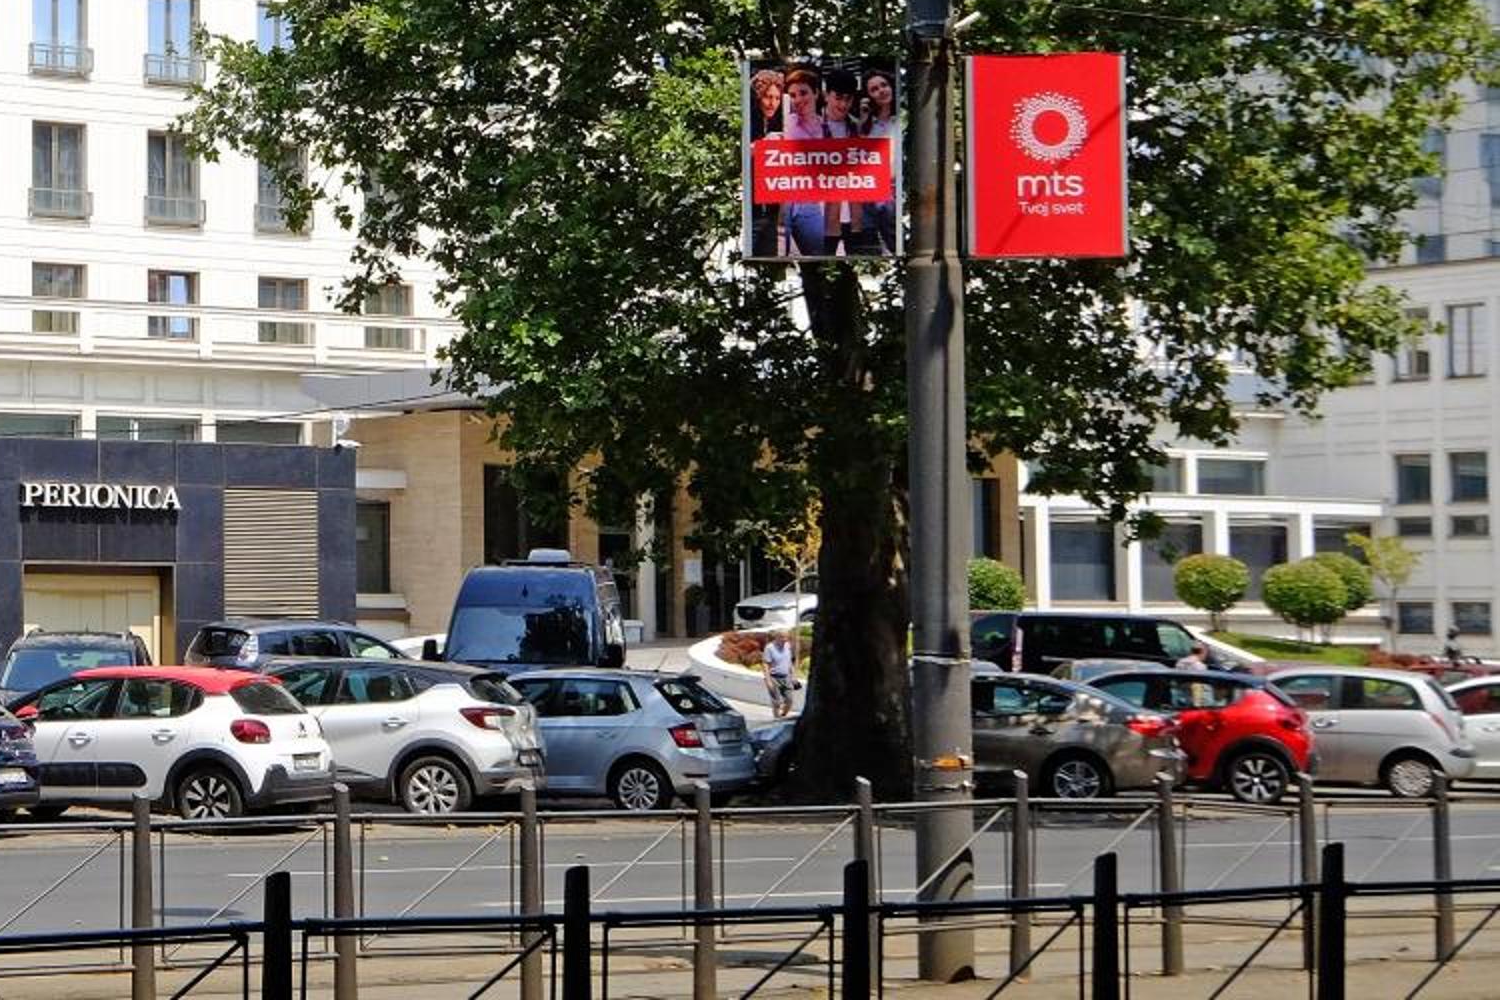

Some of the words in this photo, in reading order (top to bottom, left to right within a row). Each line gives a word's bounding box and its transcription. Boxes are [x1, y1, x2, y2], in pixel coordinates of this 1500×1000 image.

[764, 149, 842, 167] Znamo
[847, 147, 881, 165] šta
[764, 175, 813, 190] vam
[817, 172, 876, 189] treba
[1017, 171, 1084, 197] mts
[1018, 201, 1049, 216] Tvoj
[1052, 202, 1084, 215] svet
[23, 482, 181, 510] PERIONICA
